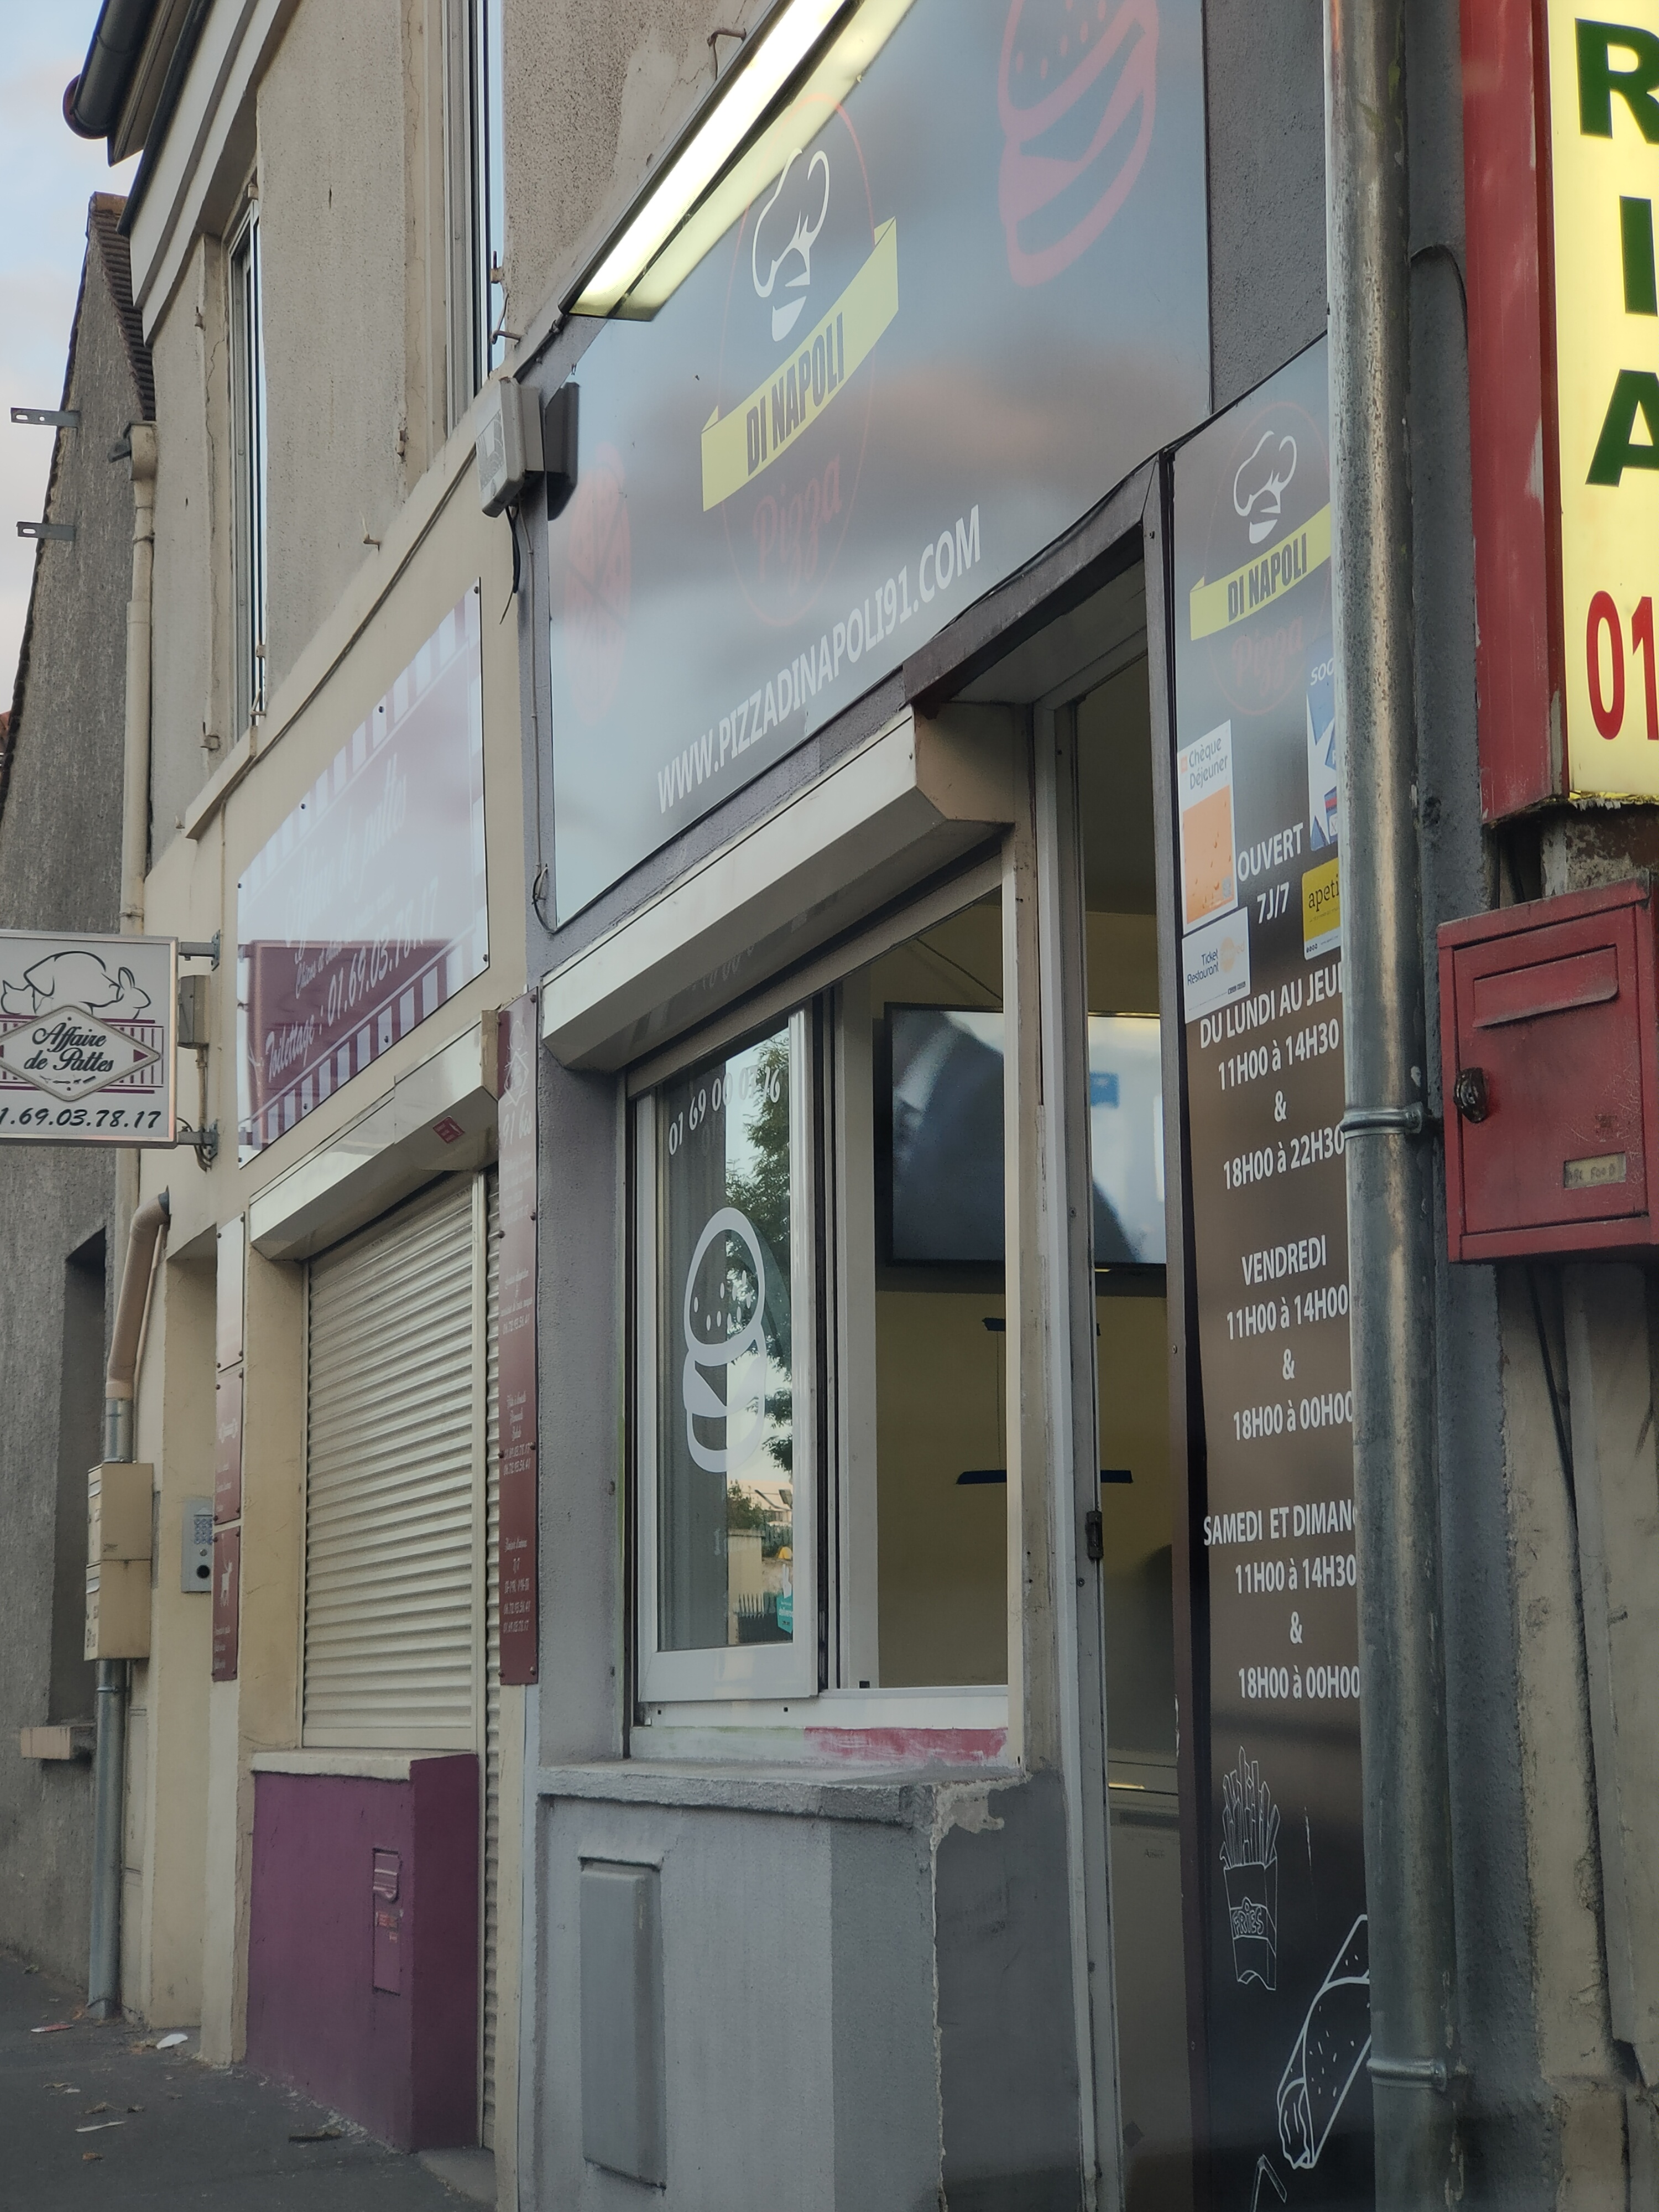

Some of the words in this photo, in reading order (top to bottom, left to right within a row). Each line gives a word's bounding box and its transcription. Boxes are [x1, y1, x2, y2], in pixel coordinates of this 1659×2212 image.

[745, 394, 768, 477] DI
[771, 311, 845, 451] NAPOLI
[752, 453, 842, 598] Pizza
[1227, 573, 1245, 623] DI
[1248, 532, 1308, 609] NAPOLI
[657, 504, 981, 815] WWW.PIZZADINAPOLI91.COM
[1188, 736, 1222, 769] Chèque
[1190, 754, 1228, 790] Déjeuner
[1237, 822, 1304, 883] OUVERT
[1256, 882, 1291, 925] 7J/7
[1187, 961, 1219, 986] Restaurant
[1202, 948, 1219, 966] Ticket
[1200, 1011, 1222, 1049] DU
[1226, 989, 1276, 1039] LUNDI
[1279, 978, 1303, 1018] AU
[1306, 961, 1343, 1008] JEU
[23, 1050, 48, 1070] de
[53, 1047, 114, 1072] Pattes
[32, 1022, 107, 1053] Affaire
[264, 1014, 315, 1083] Toilettage
[1218, 1046, 1269, 1091] 11H00
[1272, 1040, 1281, 1072] à
[1286, 1018, 1339, 1066] 14H30
[669, 1111, 684, 1156] 01
[688, 1088, 707, 1131] 69
[711, 1072, 733, 1112] 00
[1274, 1090, 1287, 1123] &
[1223, 1147, 1274, 1190] 18H00
[1277, 1141, 1287, 1173] à
[1290, 1124, 1345, 1170] 22H30
[1241, 1234, 1327, 1286] VENDREDI
[1227, 1301, 1277, 1340] 11H00
[1280, 1296, 1290, 1329] à
[1294, 1284, 1348, 1325] 14H00
[1282, 1348, 1295, 1381] &
[1233, 1404, 1284, 1441] 18H00
[1286, 1400, 1296, 1432] à
[1203, 1510, 1262, 1546] SAMEDI
[1270, 1506, 1290, 1540] ET
[1293, 1499, 1357, 1537] DIMAN
[1235, 1561, 1285, 1594] 11H00
[1288, 1558, 1298, 1590] à
[1302, 1554, 1357, 1589] 14H30
[1290, 1611, 1303, 1645] &
[1238, 1666, 1289, 1699] 18H00
[1292, 1665, 1302, 1699] à
[1306, 1665, 1360, 1699] 00H00
